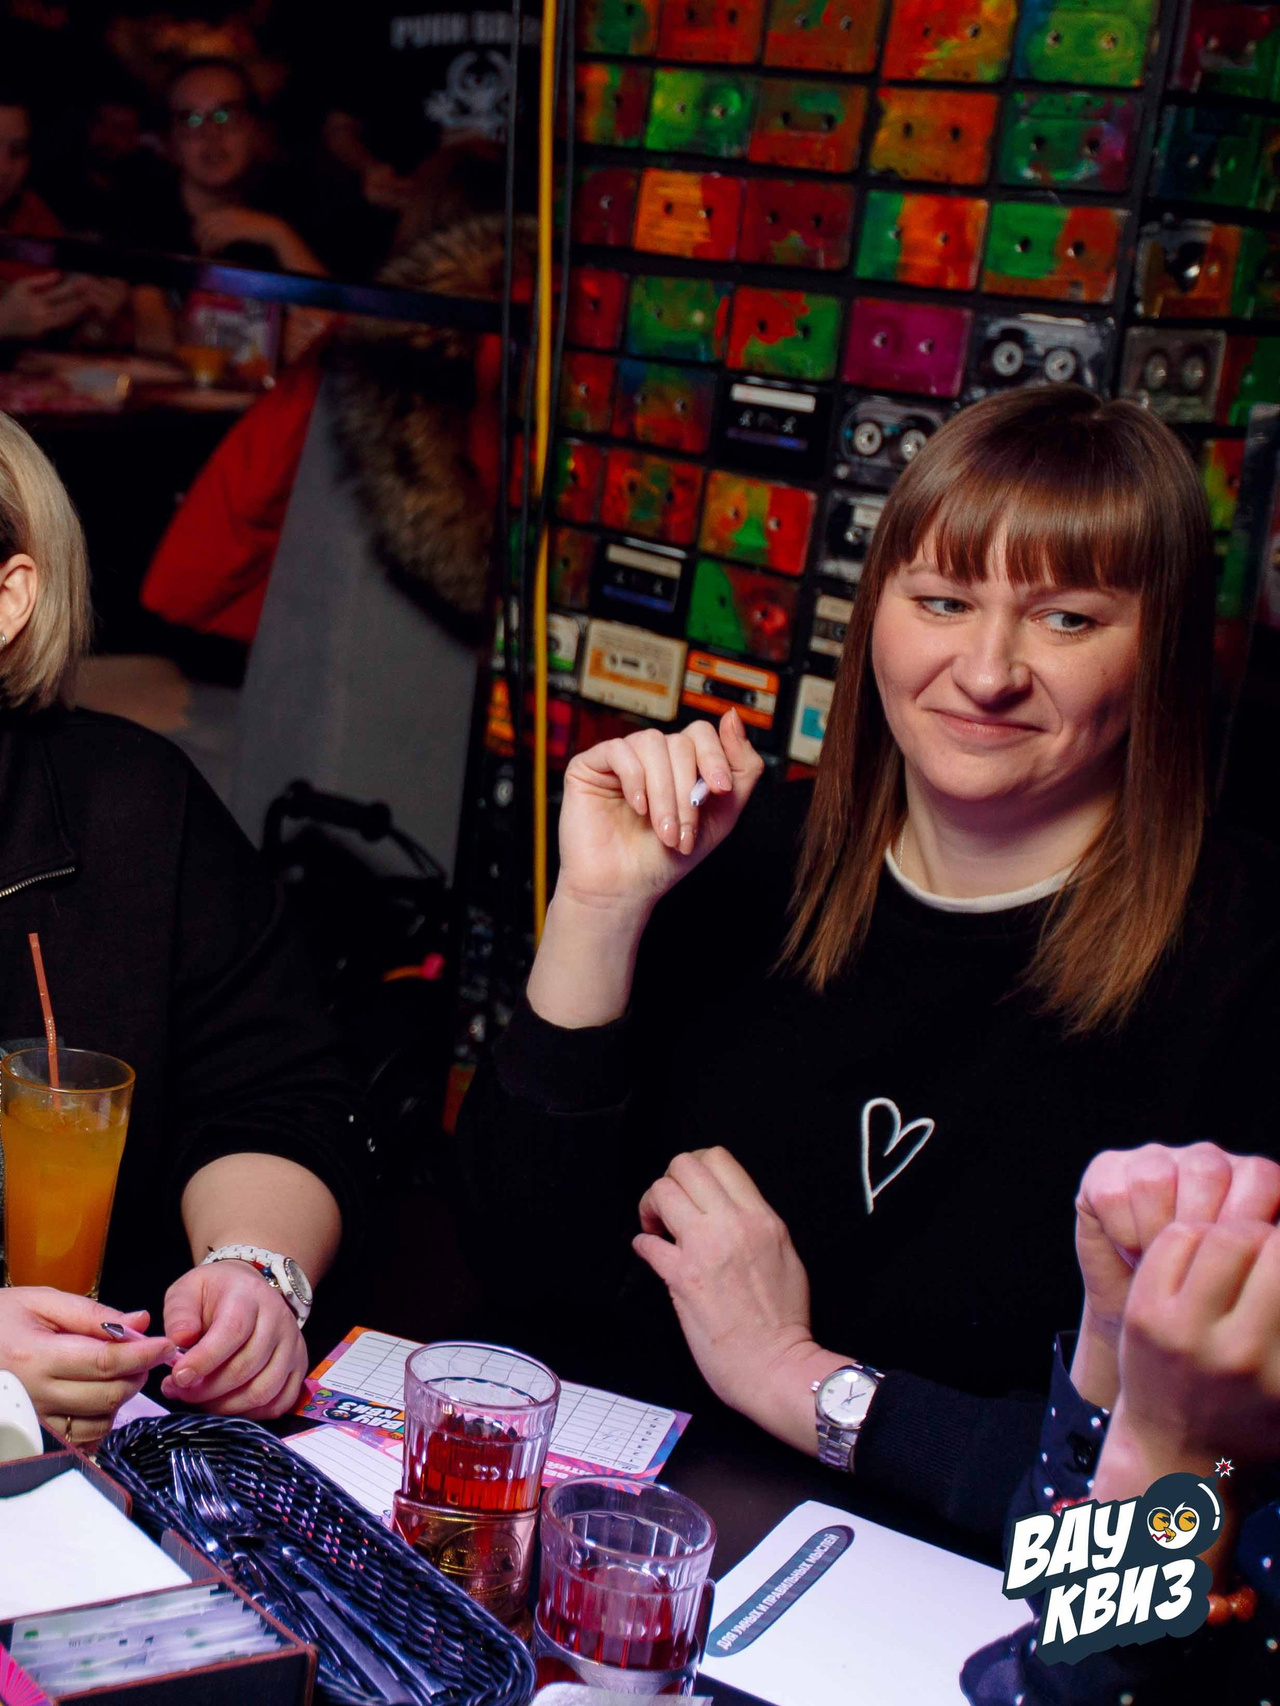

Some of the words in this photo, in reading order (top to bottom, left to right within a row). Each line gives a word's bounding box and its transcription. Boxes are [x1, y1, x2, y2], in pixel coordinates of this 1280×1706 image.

[338, 1401, 400, 1419] КВИЗ
[351, 1414, 405, 1431] ВАУ
[805, 1533, 840, 1564] МЫСЛЕЙ
[762, 1561, 813, 1606] ПРАВИЛЬНЫХ
[757, 1603, 769, 1615] И
[731, 1608, 763, 1635] УМНЫХ
[717, 1627, 738, 1651] ДЛЯ
